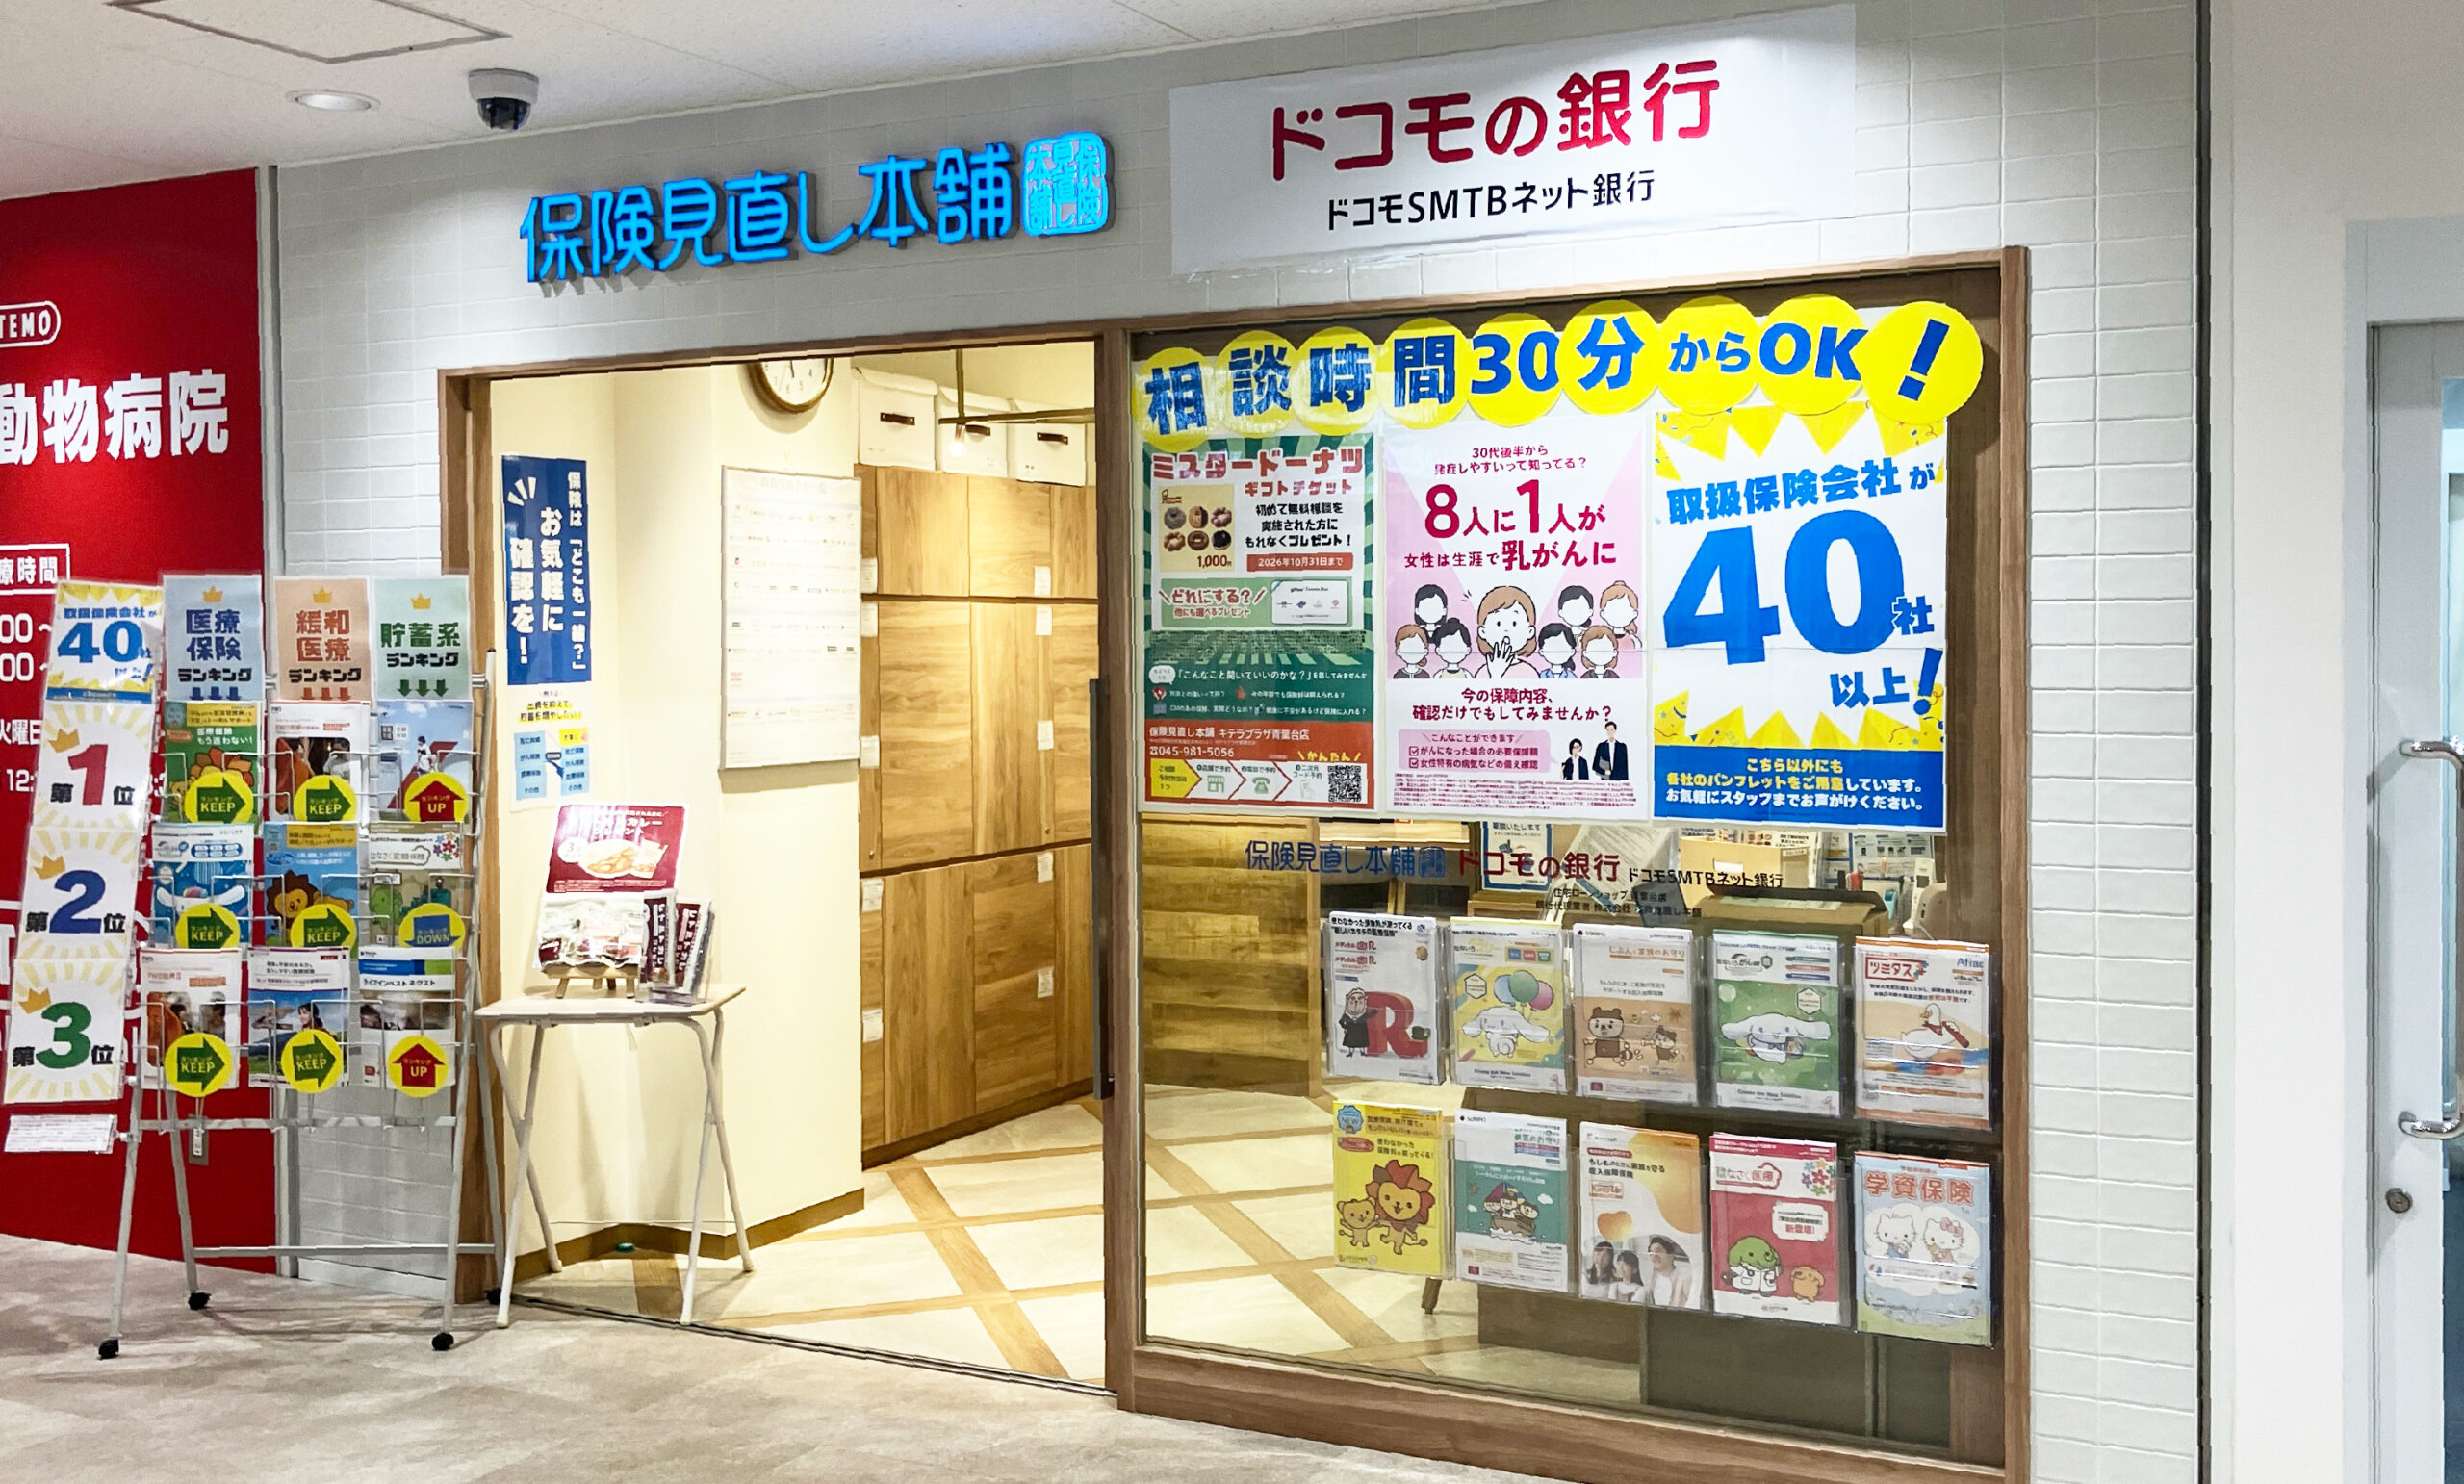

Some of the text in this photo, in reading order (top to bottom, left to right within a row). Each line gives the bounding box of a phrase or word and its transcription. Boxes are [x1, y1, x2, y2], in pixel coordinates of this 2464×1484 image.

[1272, 59, 1720, 182] ドコモの銀行
[1327, 170, 1656, 231] ドコモSMTBネット銀行
[521, 141, 1013, 283] 保険見直し本舗
[0, 368, 229, 466] 動物病院
[1472, 445, 1549, 459] 30代後半から
[1153, 448, 1363, 480] ミスタードーナツ
[1434, 457, 1587, 475] 発症しやすいって知ってる？
[1245, 479, 1352, 497] ギフトチケット
[1666, 457, 1937, 525] 取扱保険会社が
[1256, 502, 1343, 515] 初めて無料相談を
[1424, 479, 1606, 539] 8人に1人が
[1261, 518, 1339, 531] 実施された方に
[1258, 557, 1344, 568] 2026年10月31日まで
[1404, 540, 1617, 571] 女性は生涯で乳がんに
[539, 506, 565, 632] お気軽に
[186, 609, 241, 634] 医療
[296, 609, 350, 635] 緩和
[380, 622, 461, 649] 貯蓄系
[187, 636, 242, 662] 保険
[296, 637, 351, 662] 医療
[386, 652, 459, 668] ランキング
[178, 667, 252, 683] ランキング
[288, 667, 362, 683] ランキング
[1412, 704, 1612, 722] 確認だけでもしてみませんか？
[1149, 727, 1216, 739] 保険見直し本舗
[1430, 733, 1516, 743] こんなことができます
[1158, 746, 1235, 757] 045-981-5056
[50, 744, 135, 806] 第1位
[1747, 758, 1844, 774] こちら以外にも
[1666, 772, 1922, 793] 各社のパンフレットをご用意しています。
[200, 802, 236, 813] KEEP
[427, 803, 447, 813] UP
[1665, 788, 1923, 810] お気軽にスタッフまでお声がけください。
[309, 804, 343, 815] KEEP
[1245, 839, 1415, 877] 保険見直し本舗
[1457, 850, 1621, 882] ドコモの銀行
[1629, 867, 1784, 887] ドコモSMTBネット銀行
[26, 870, 126, 934] 第2位
[191, 931, 223, 941] KEEP
[307, 932, 341, 943] KEEP
[416, 934, 450, 944] DOWN
[1869, 961, 1912, 978] ツミタス
[13, 1002, 115, 1069] 第3位
[180, 1062, 216, 1074] KEEP
[295, 1058, 327, 1071] KEEP
[410, 1066, 428, 1077] UP
[1863, 1169, 1974, 1207] 学資保険
